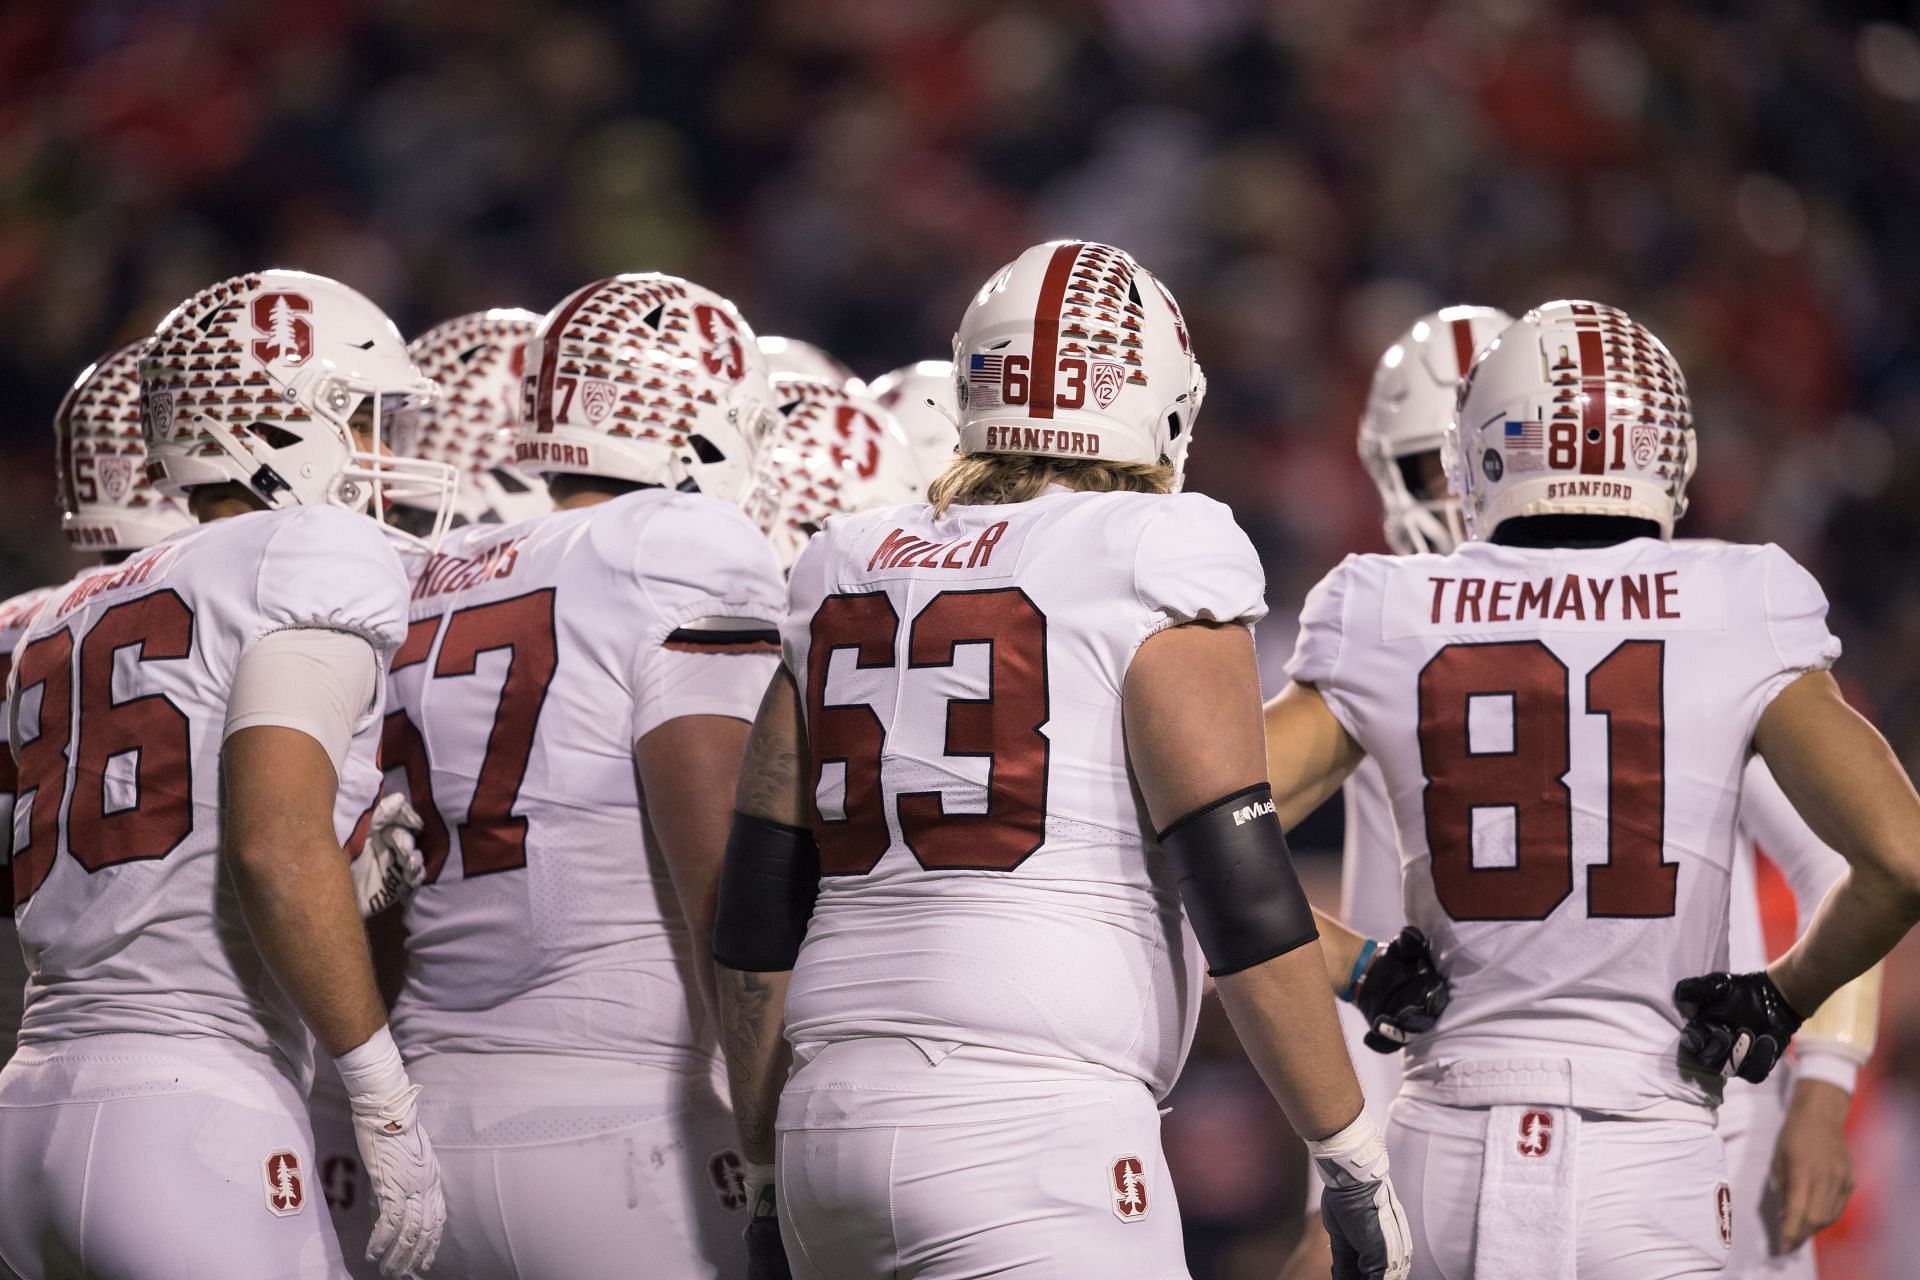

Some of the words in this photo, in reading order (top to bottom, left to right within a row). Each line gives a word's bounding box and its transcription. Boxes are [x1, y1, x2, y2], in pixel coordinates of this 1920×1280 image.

[1099, 386, 1113, 400] 12
[987, 426, 1100, 456] STANFORD
[1547, 481, 1632, 500] STANFORD
[867, 521, 1009, 571] MILLER
[1428, 570, 1681, 624] TREMAYNE
[806, 586, 1050, 876] 63
[1417, 639, 1680, 922] 81
